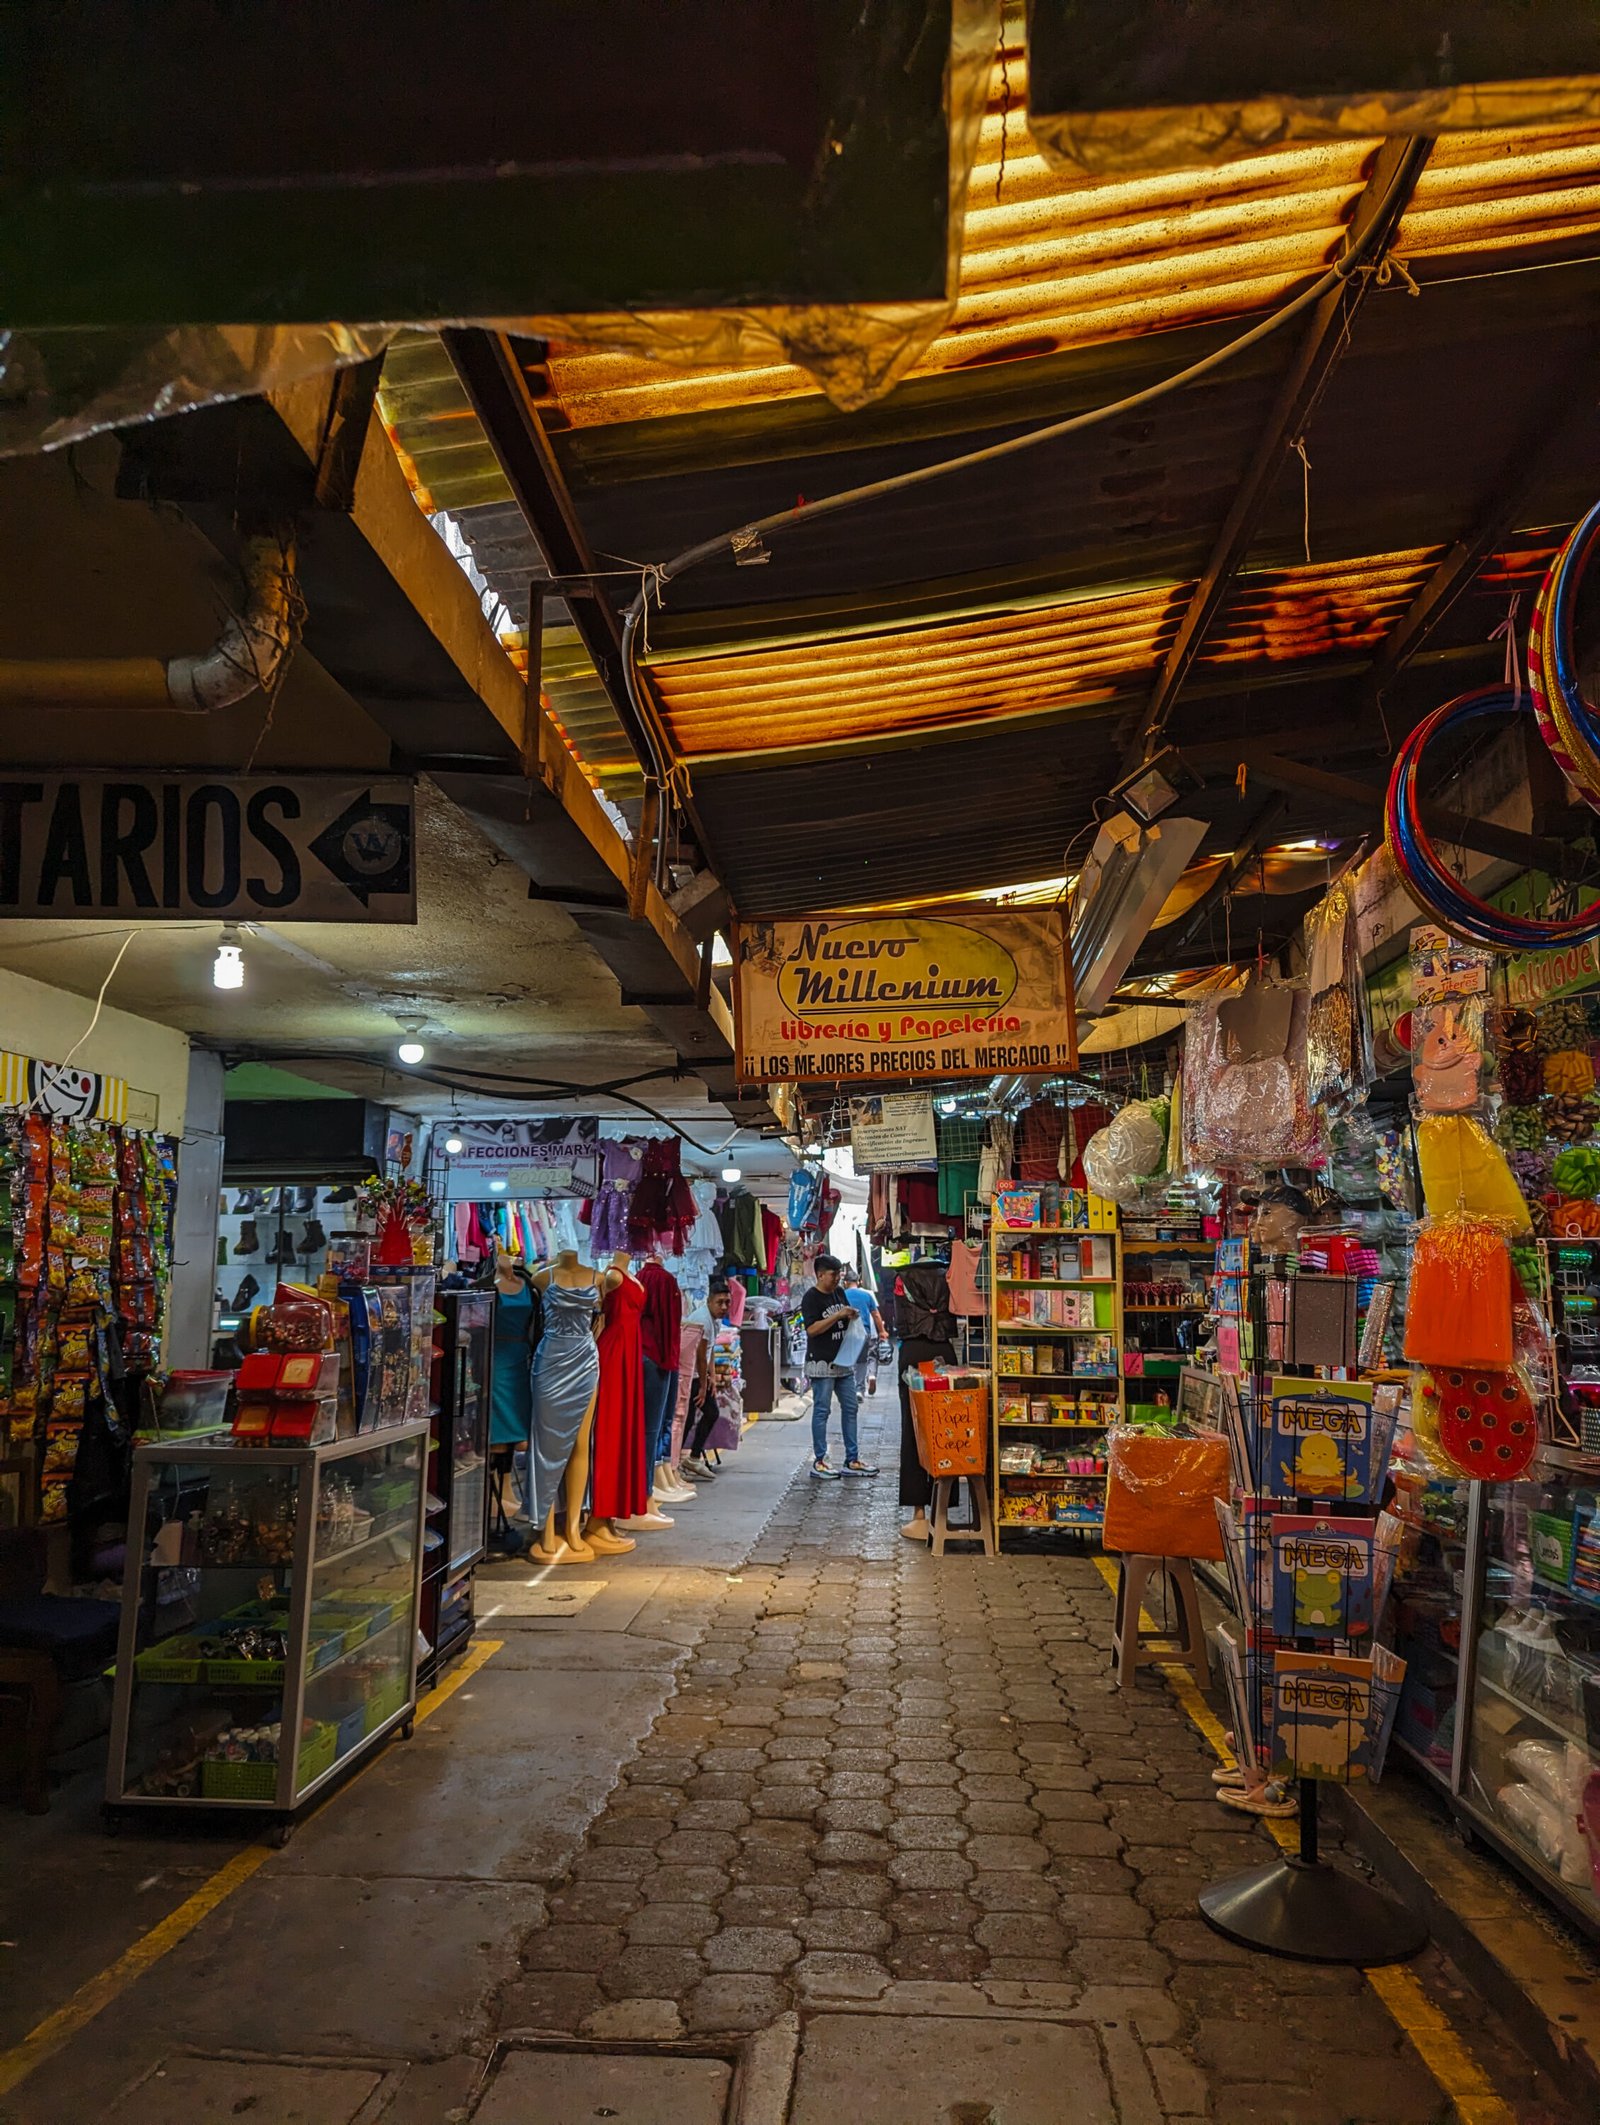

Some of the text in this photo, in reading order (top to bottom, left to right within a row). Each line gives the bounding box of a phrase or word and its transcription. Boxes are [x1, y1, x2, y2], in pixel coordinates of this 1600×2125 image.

[786, 922, 920, 962] Nuevo
[792, 964, 1003, 1005] Millenium
[878, 1021, 892, 1043] y
[900, 1013, 1021, 1038] Papelería
[760, 1055, 789, 1076] LOS
[794, 1052, 865, 1075] MEJORES
[870, 1049, 936, 1073] PRECIOS
[942, 1047, 970, 1070] DEL
[974, 1044, 1050, 1068] MERCADO
[552, 1143, 592, 1156] MARY
[936, 1407, 971, 1428] Papel
[1282, 1405, 1362, 1434] MEGA
[1283, 1542, 1364, 1570] MEGA
[1283, 1680, 1365, 1713] MEGA
